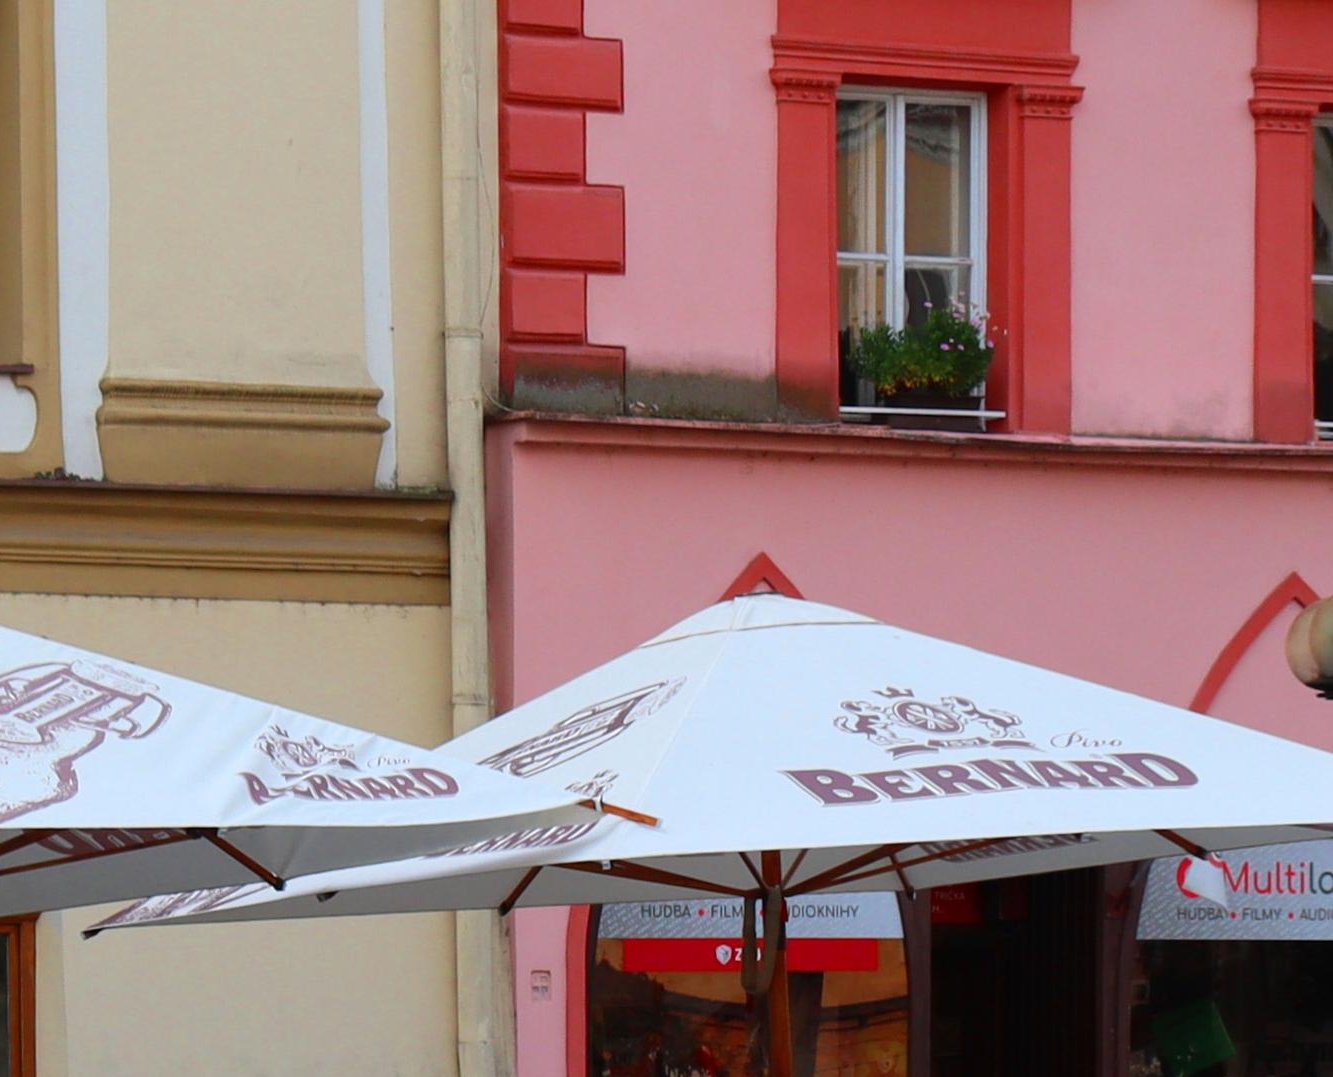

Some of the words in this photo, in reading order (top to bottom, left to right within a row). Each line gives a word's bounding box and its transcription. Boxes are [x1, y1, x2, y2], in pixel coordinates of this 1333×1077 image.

[1049, 728, 1124, 749] Pivo
[777, 752, 1200, 808] BERNARD
[640, 904, 692, 919] HUDBA
[710, 904, 744, 918] FILM
[787, 903, 860, 918] DIOKNIHY
[1177, 907, 1226, 921] HUDBA
[1241, 907, 1282, 921] FILMY
[1299, 907, 1333, 922] AUDI
